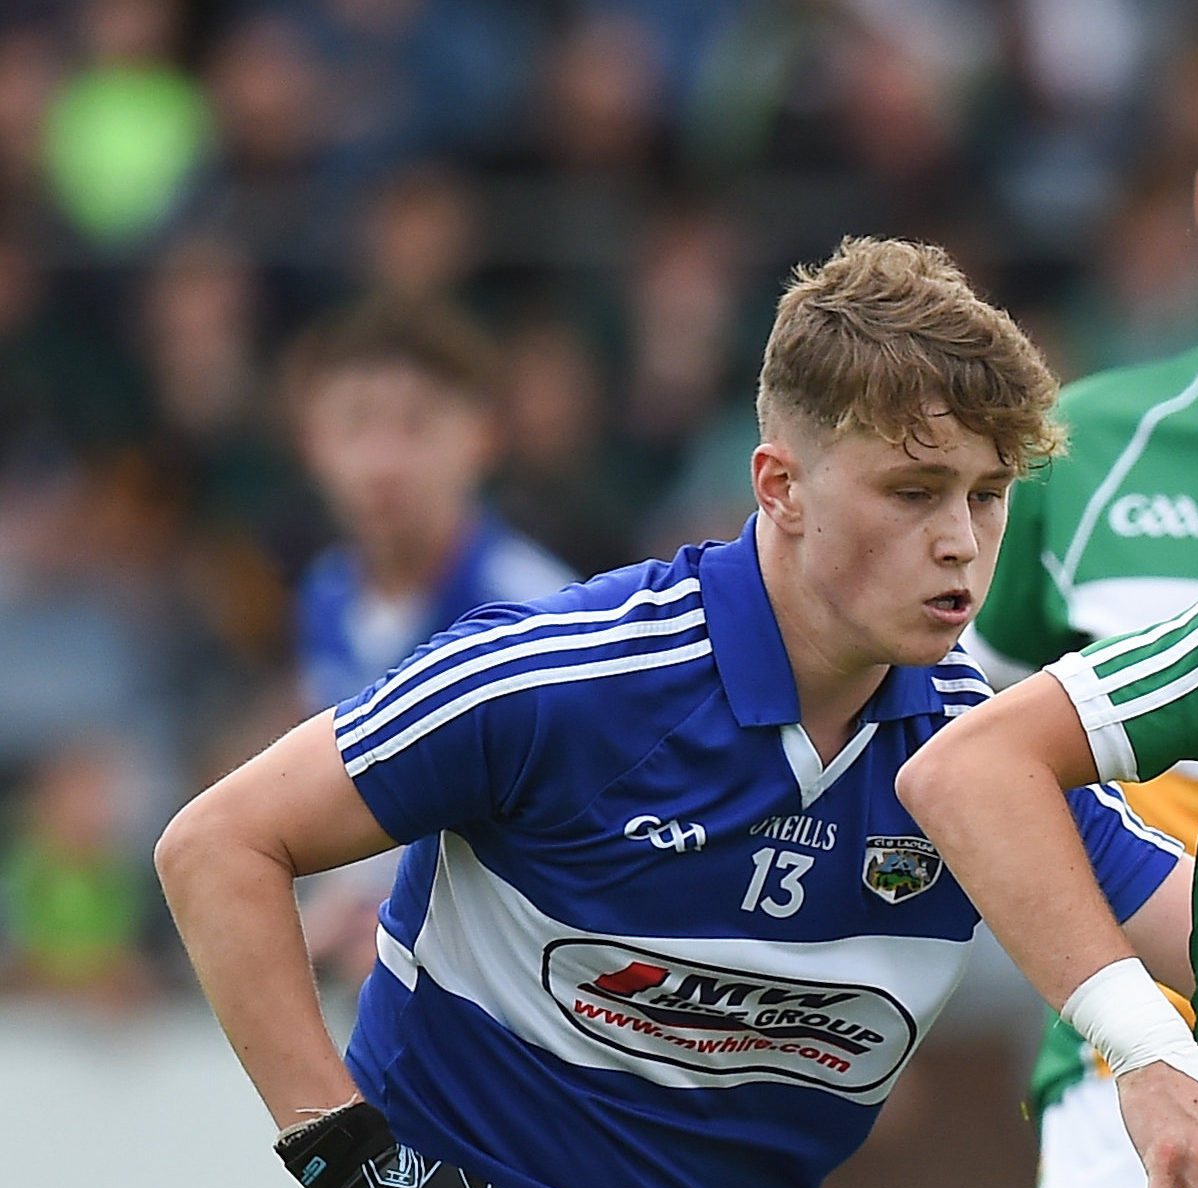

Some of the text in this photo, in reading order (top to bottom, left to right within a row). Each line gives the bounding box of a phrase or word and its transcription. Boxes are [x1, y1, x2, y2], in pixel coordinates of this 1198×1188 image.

[741, 847, 815, 918] 13
[670, 973, 861, 1009] MW
[574, 999, 851, 1073] www.mwhire.com
[754, 1009, 884, 1043] GROUP
